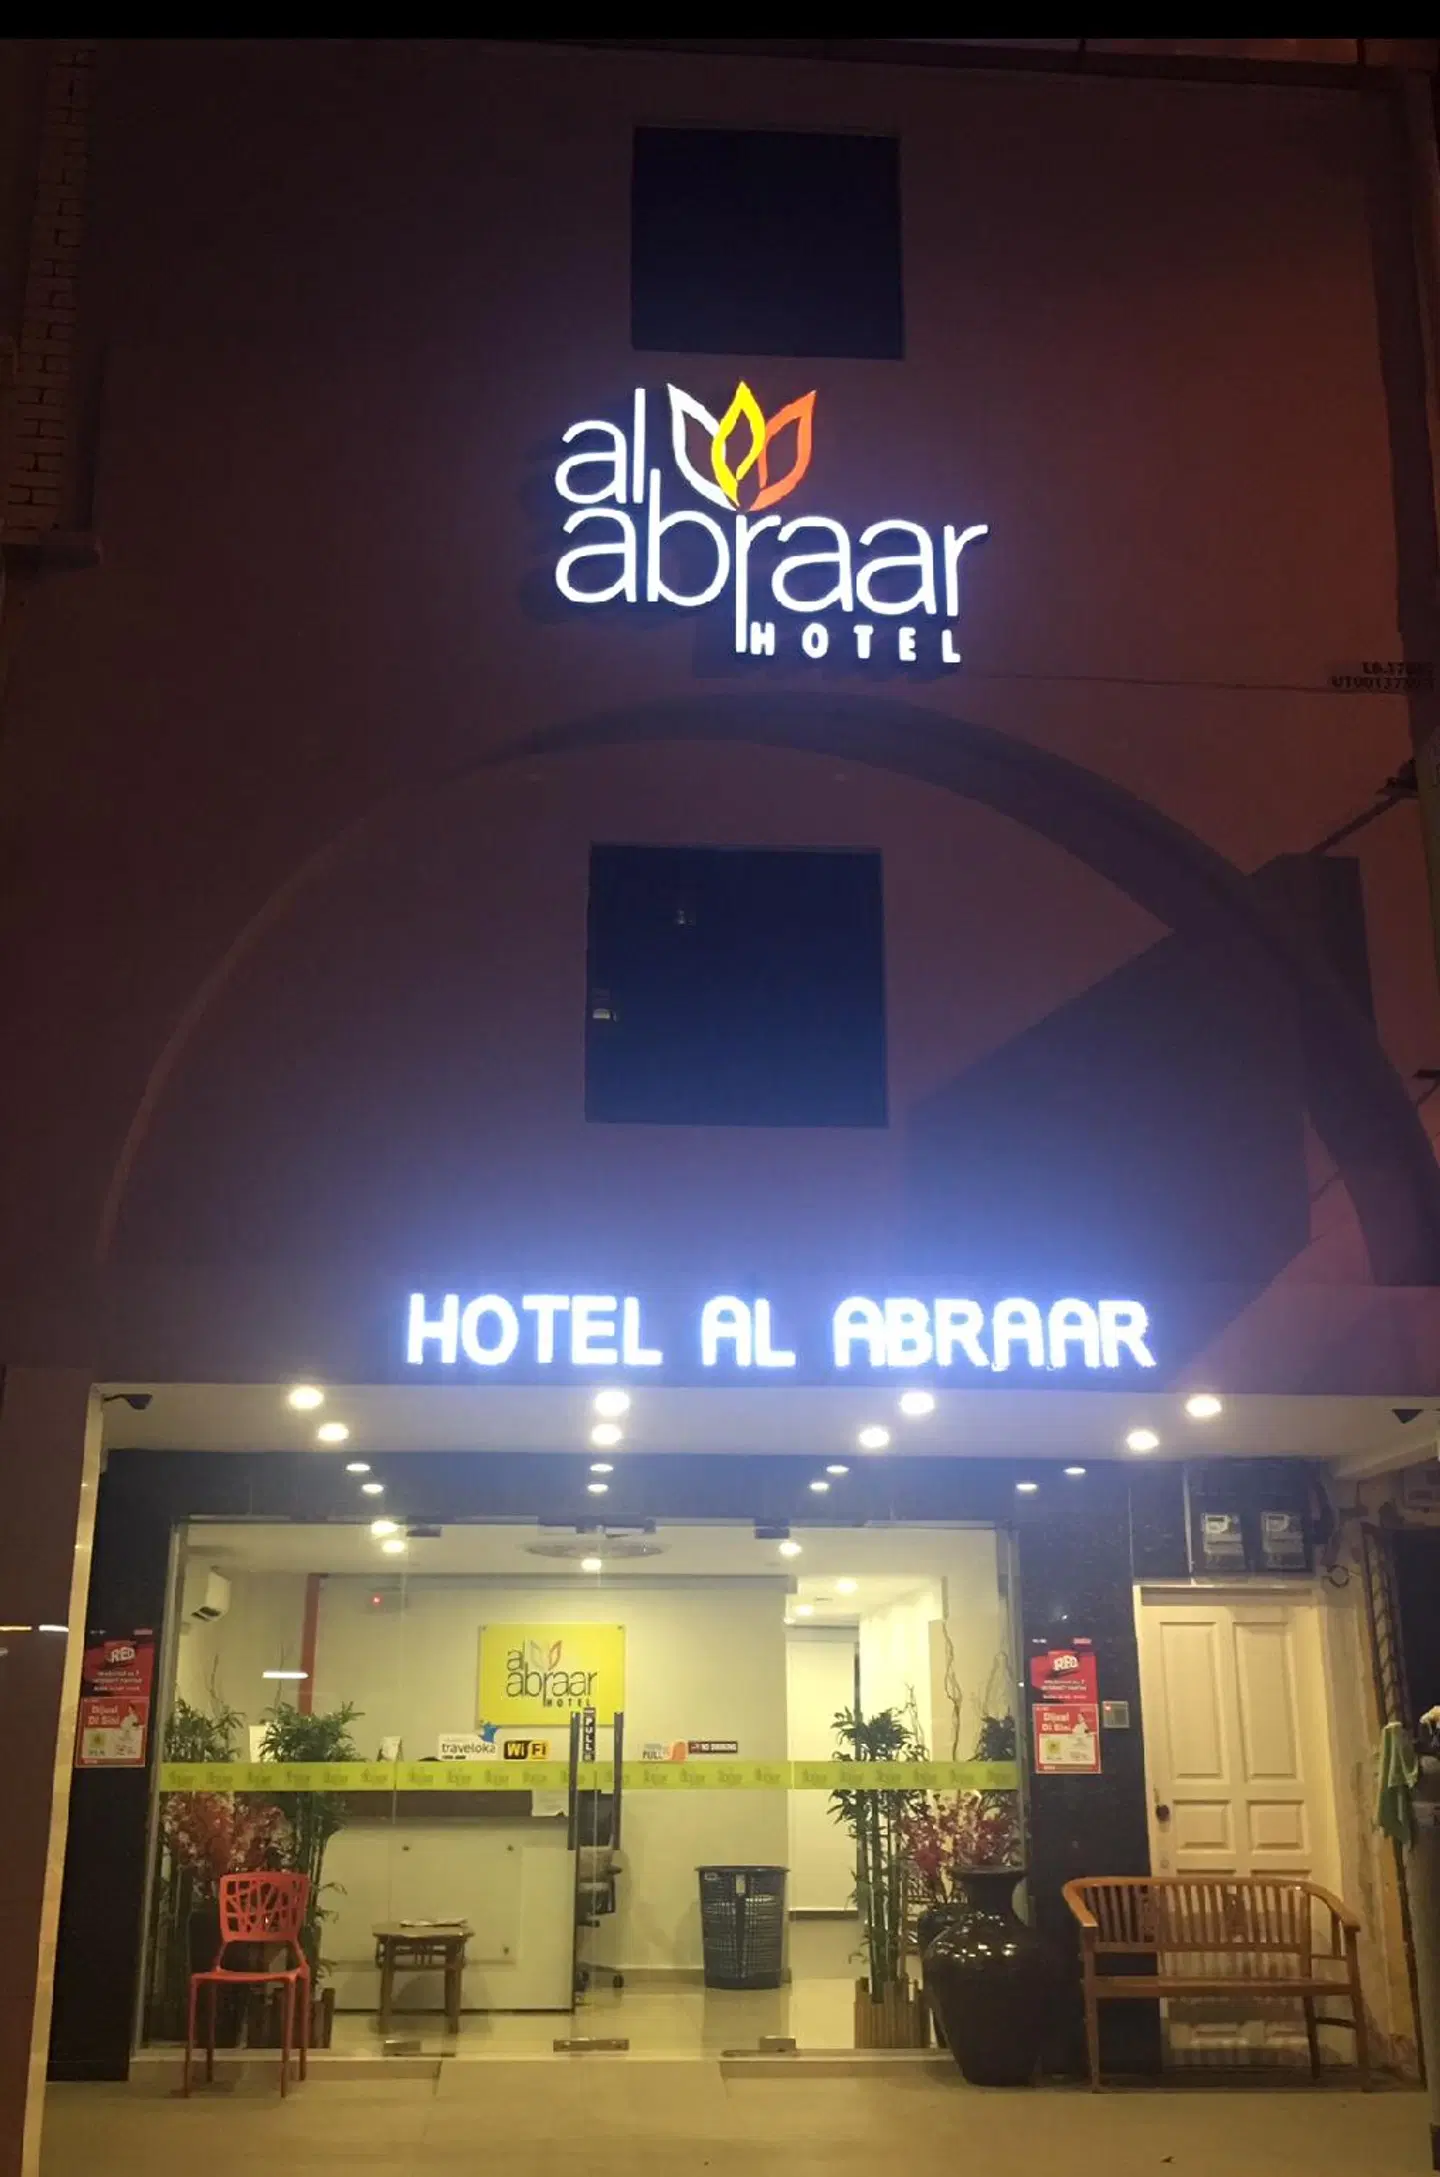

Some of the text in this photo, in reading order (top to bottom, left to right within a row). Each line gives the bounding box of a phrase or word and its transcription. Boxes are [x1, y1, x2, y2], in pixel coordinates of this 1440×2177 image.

[555, 388, 646, 504] al
[555, 468, 989, 653] abraar
[749, 621, 962, 664] HOTEL
[406, 1293, 1157, 1371] HOTEL AL ABRAAR
[506, 1661, 598, 1708] abraar
[441, 1743, 496, 1753] traveloka
[585, 1717, 594, 1751] PULL
